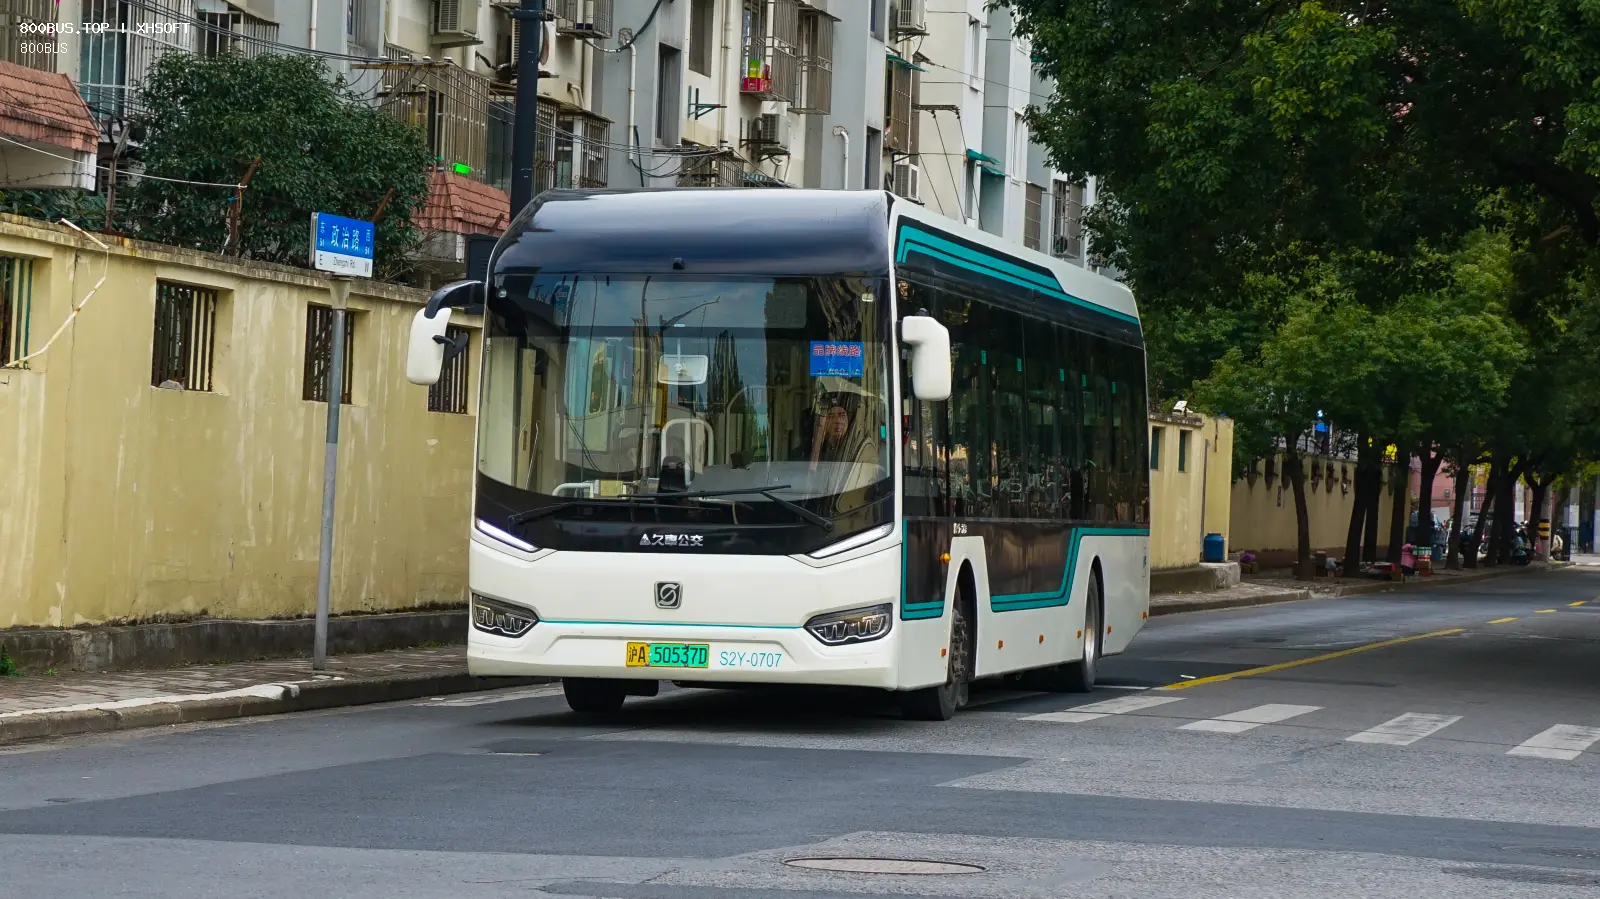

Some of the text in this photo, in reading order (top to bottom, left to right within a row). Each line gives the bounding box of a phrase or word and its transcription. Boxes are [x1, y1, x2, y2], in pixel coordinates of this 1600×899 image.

[331, 224, 360, 251] 政治路
[319, 254, 323, 266] E
[813, 344, 861, 357] 品牌线路
[653, 646, 707, 665] 50537D
[719, 651, 782, 668] S2Y-0707
